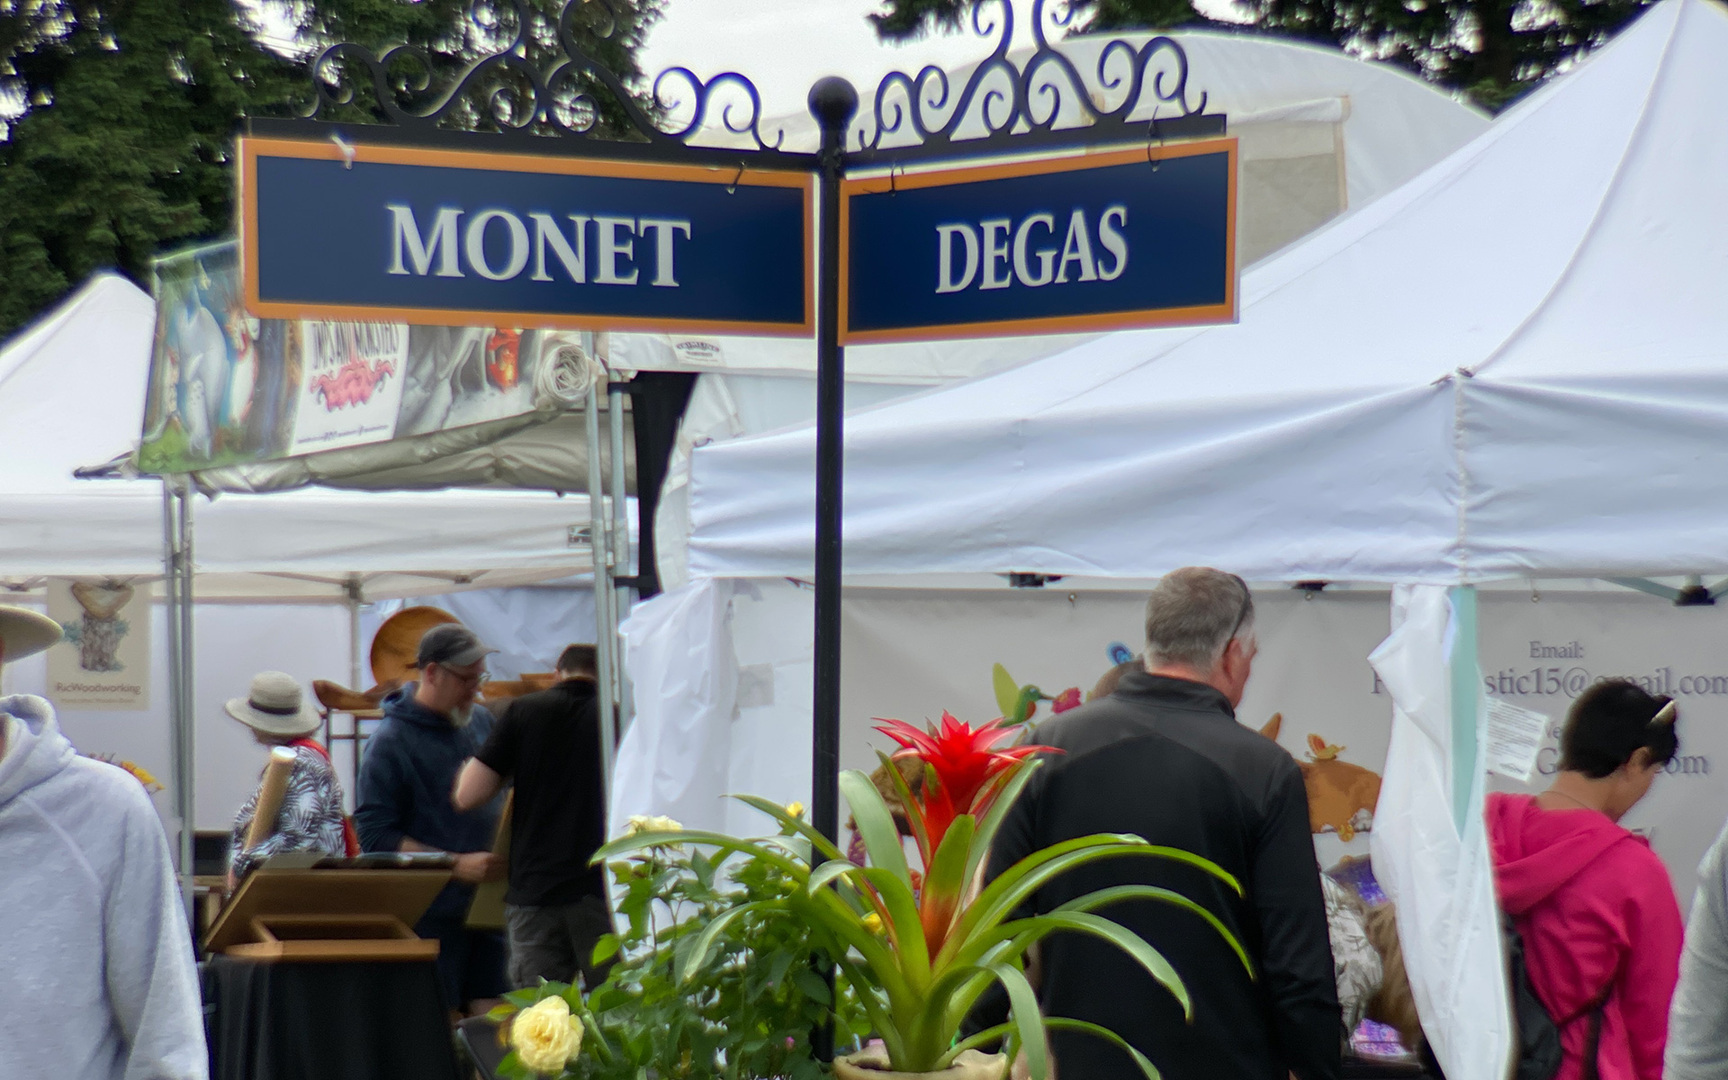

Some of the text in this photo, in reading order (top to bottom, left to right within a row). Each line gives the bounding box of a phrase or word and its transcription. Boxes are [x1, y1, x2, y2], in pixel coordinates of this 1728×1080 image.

[386, 205, 691, 287] MONET
[936, 206, 1127, 293] DEGAS
[1529, 641, 1584, 658] Email:
